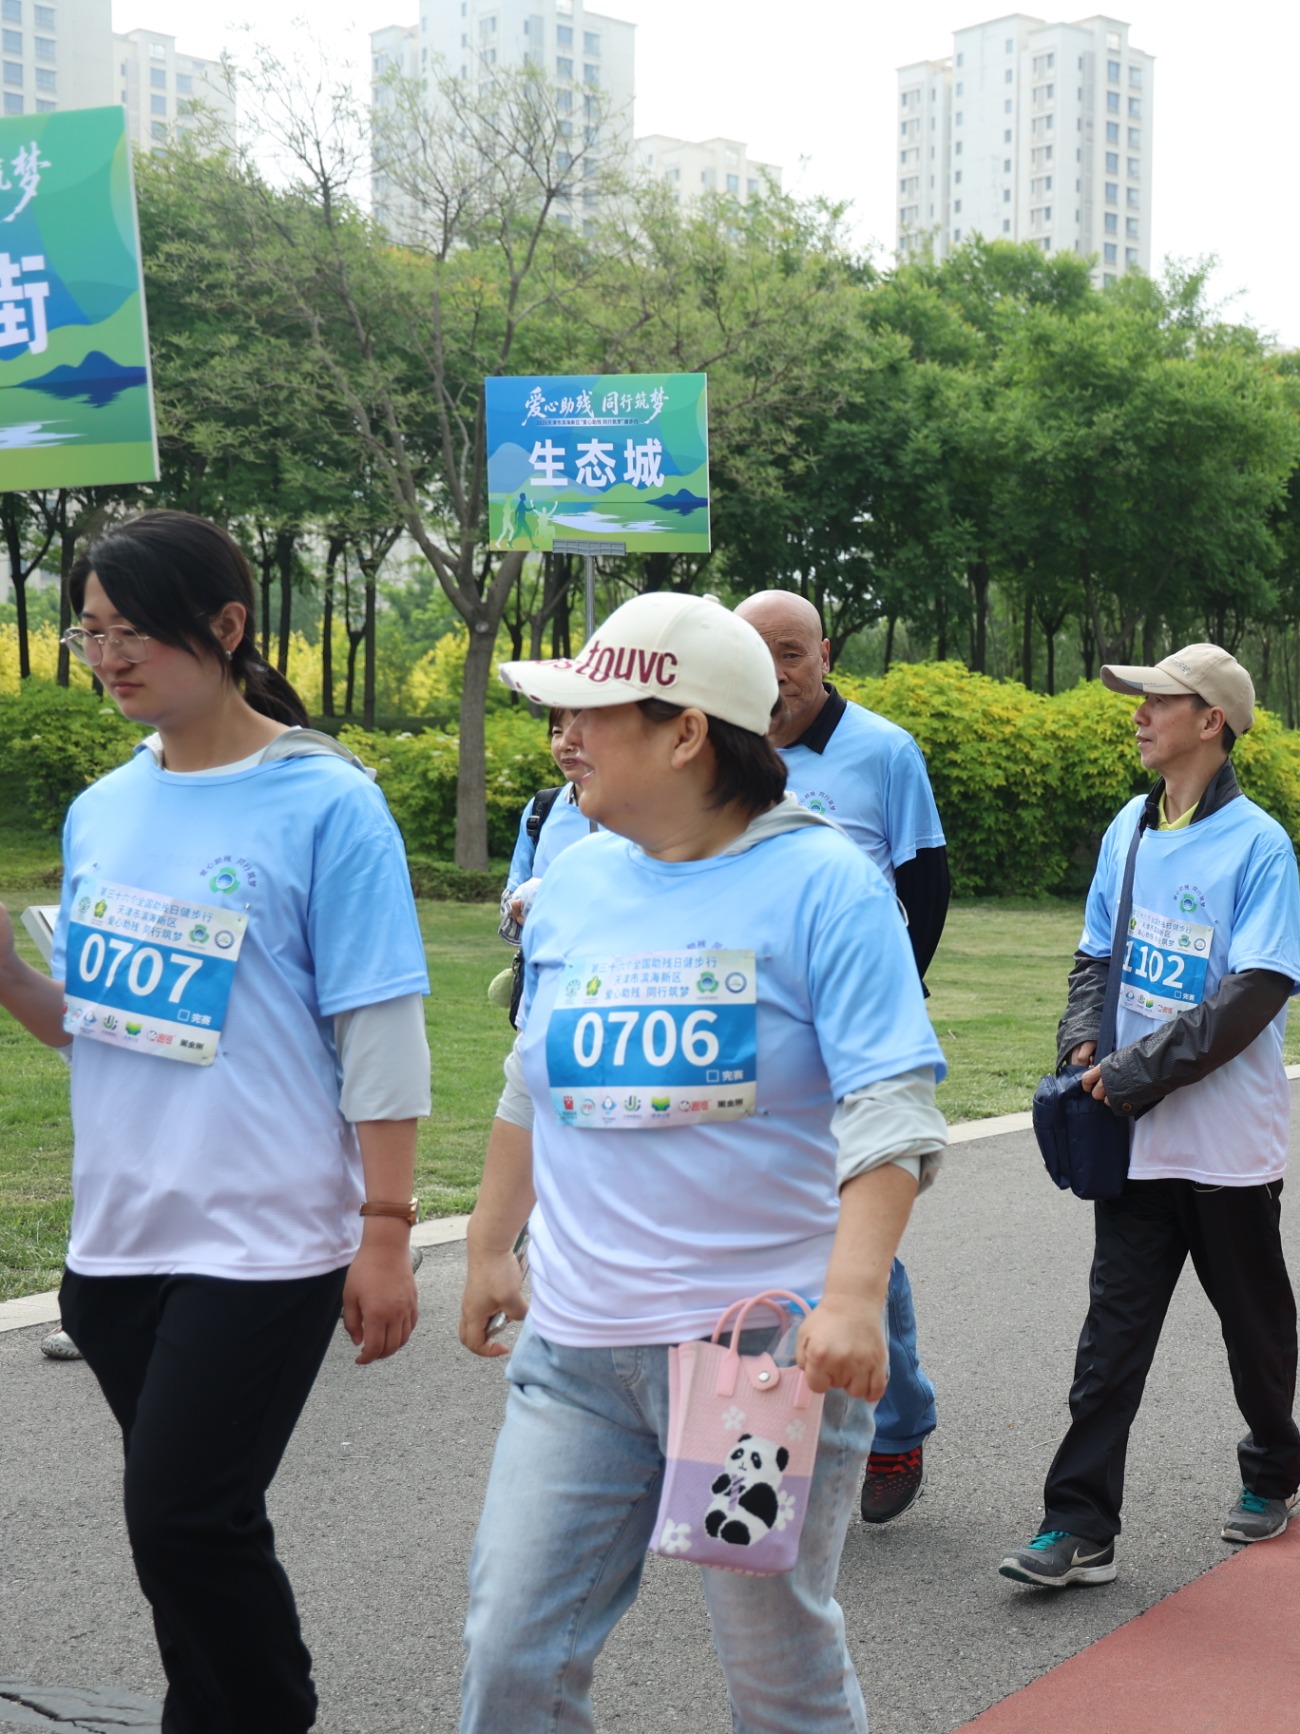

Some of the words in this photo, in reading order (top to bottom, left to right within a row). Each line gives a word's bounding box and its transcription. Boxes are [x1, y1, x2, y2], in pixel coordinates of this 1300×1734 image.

[0, 141, 51, 222] 梦
[521, 386, 594, 427] 爱心助残
[602, 386, 669, 424] 同行筑梦
[528, 438, 665, 488] 生态城
[79, 933, 203, 1003] 0707
[1122, 940, 1185, 989] 1102
[573, 1010, 719, 1068] 0706
